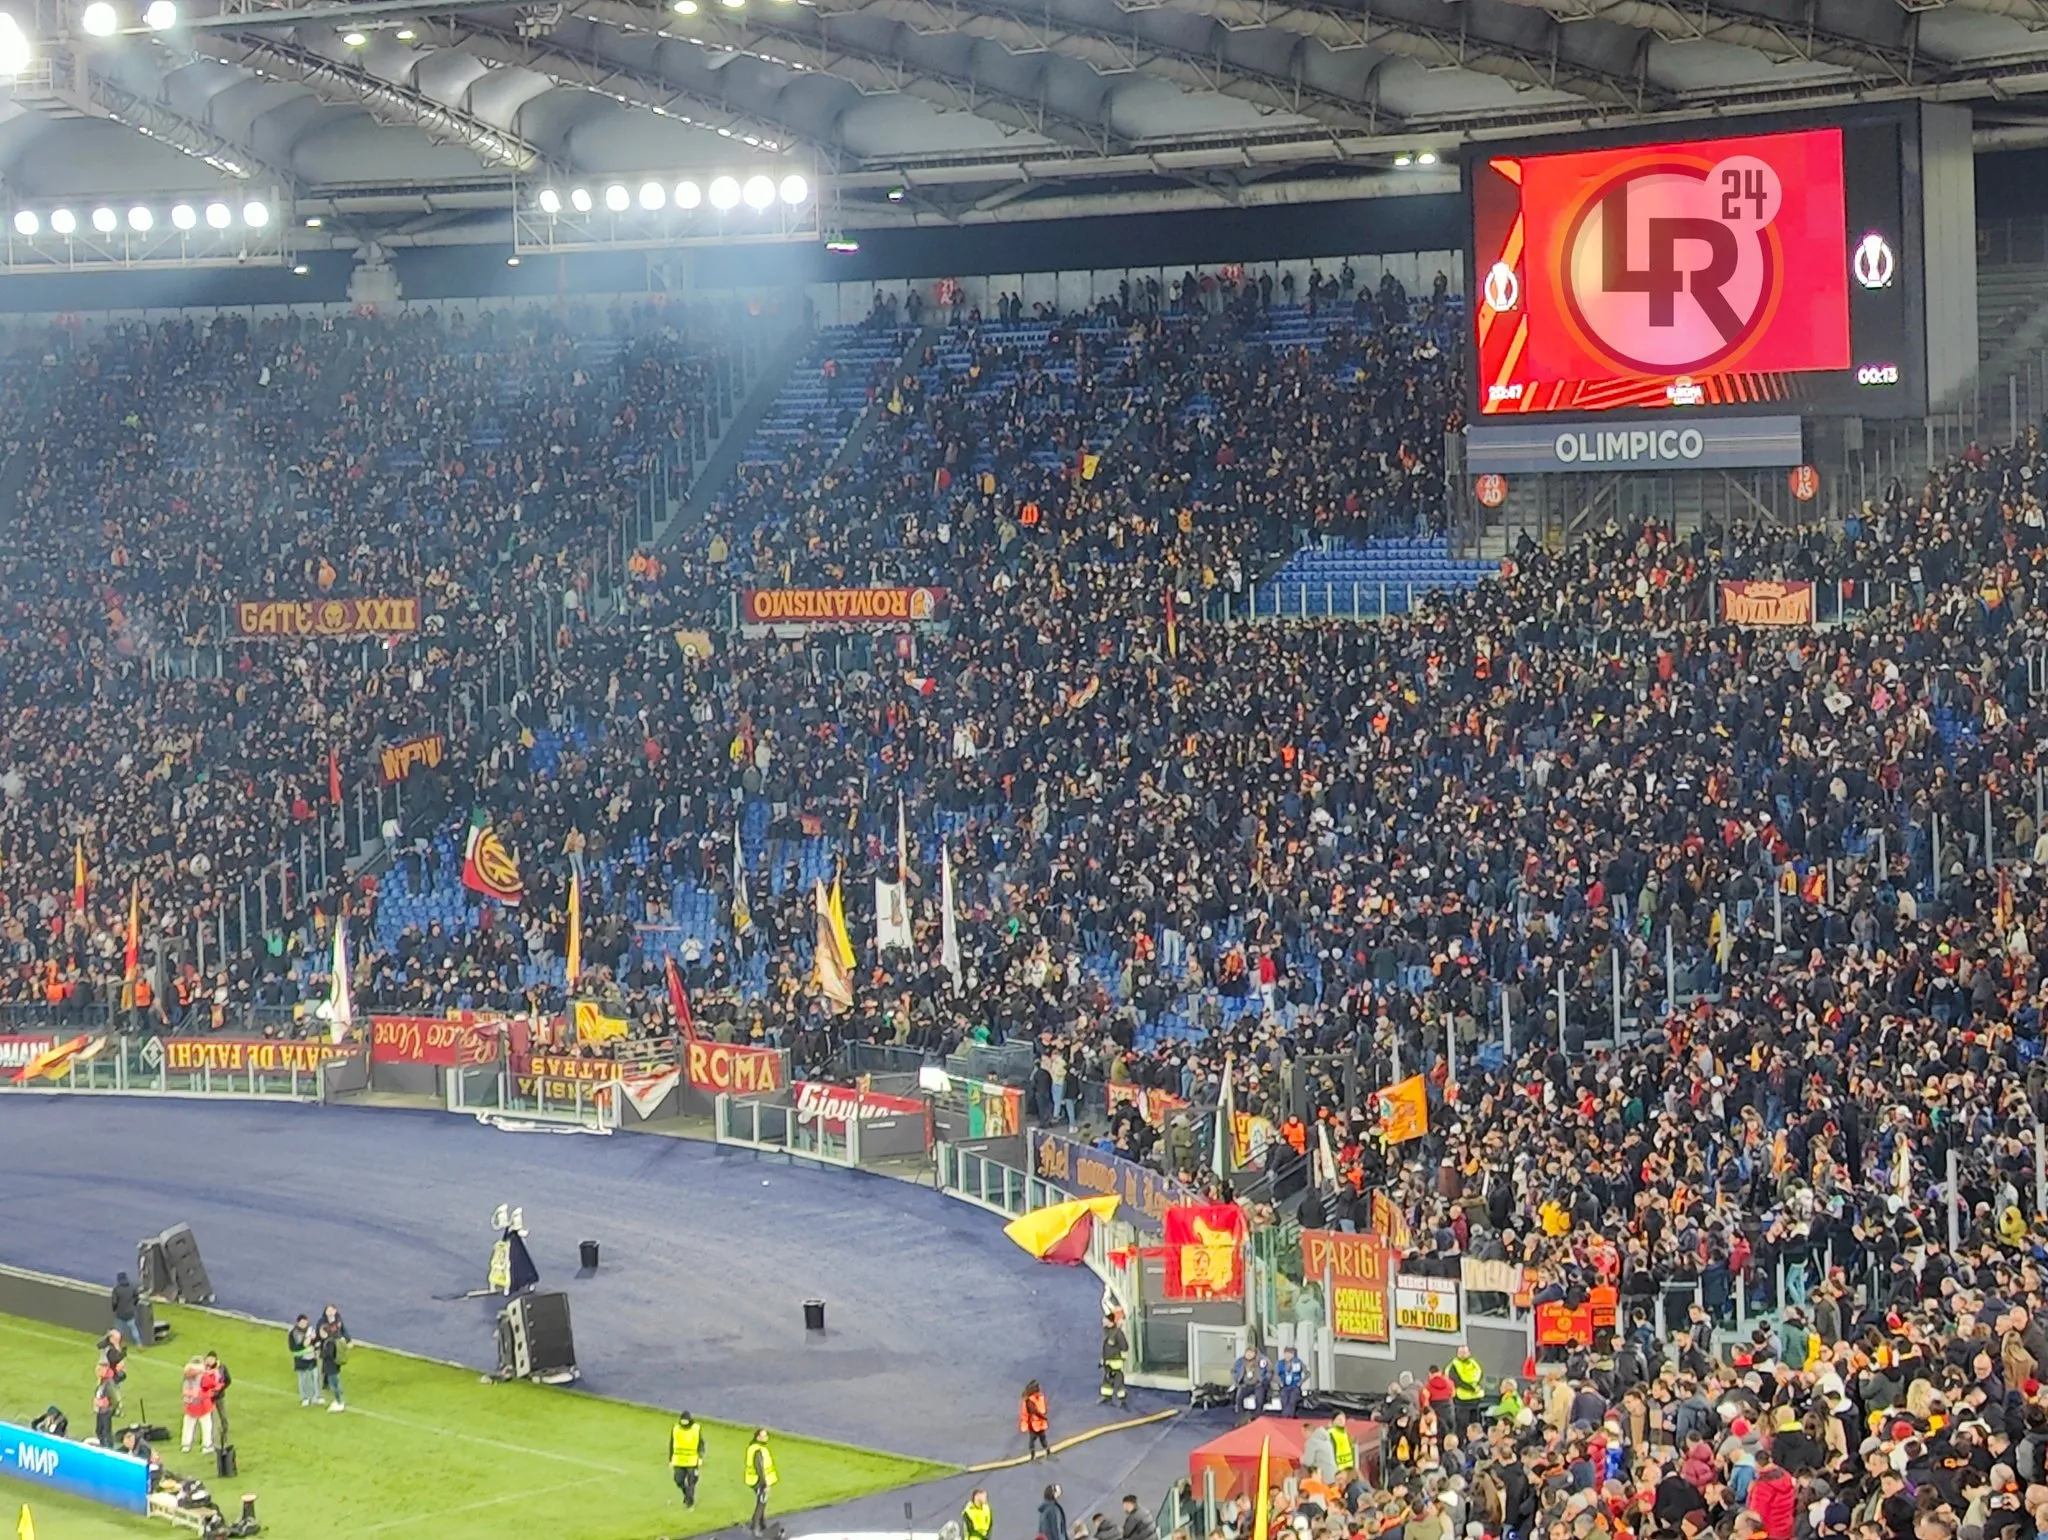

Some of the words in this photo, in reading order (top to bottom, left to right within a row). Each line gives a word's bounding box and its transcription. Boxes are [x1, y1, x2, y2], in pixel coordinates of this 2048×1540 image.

[1721, 169, 1767, 220] 24
[1857, 366, 1899, 385] 00:13
[1554, 428, 1705, 463] OLIMPICO
[1483, 474, 1500, 489] 20
[1797, 465, 1811, 482] 19
[1482, 488, 1502, 505] AD
[1796, 480, 1814, 498] AS
[240, 602, 313, 634] GATE
[355, 599, 416, 631] XXII
[754, 590, 908, 618] ROMANISMO
[167, 1043, 242, 1070] FALCHI
[531, 1057, 624, 1080] ULTRAS
[689, 1043, 776, 1093] ROMA
[1335, 1288, 1382, 1313] CORVIALE
[1335, 1309, 1384, 1337] PRESENTE
[1401, 1308, 1418, 1325] ON
[1420, 1311, 1452, 1329] TOUR
[18, 1441, 59, 1477] МИР
